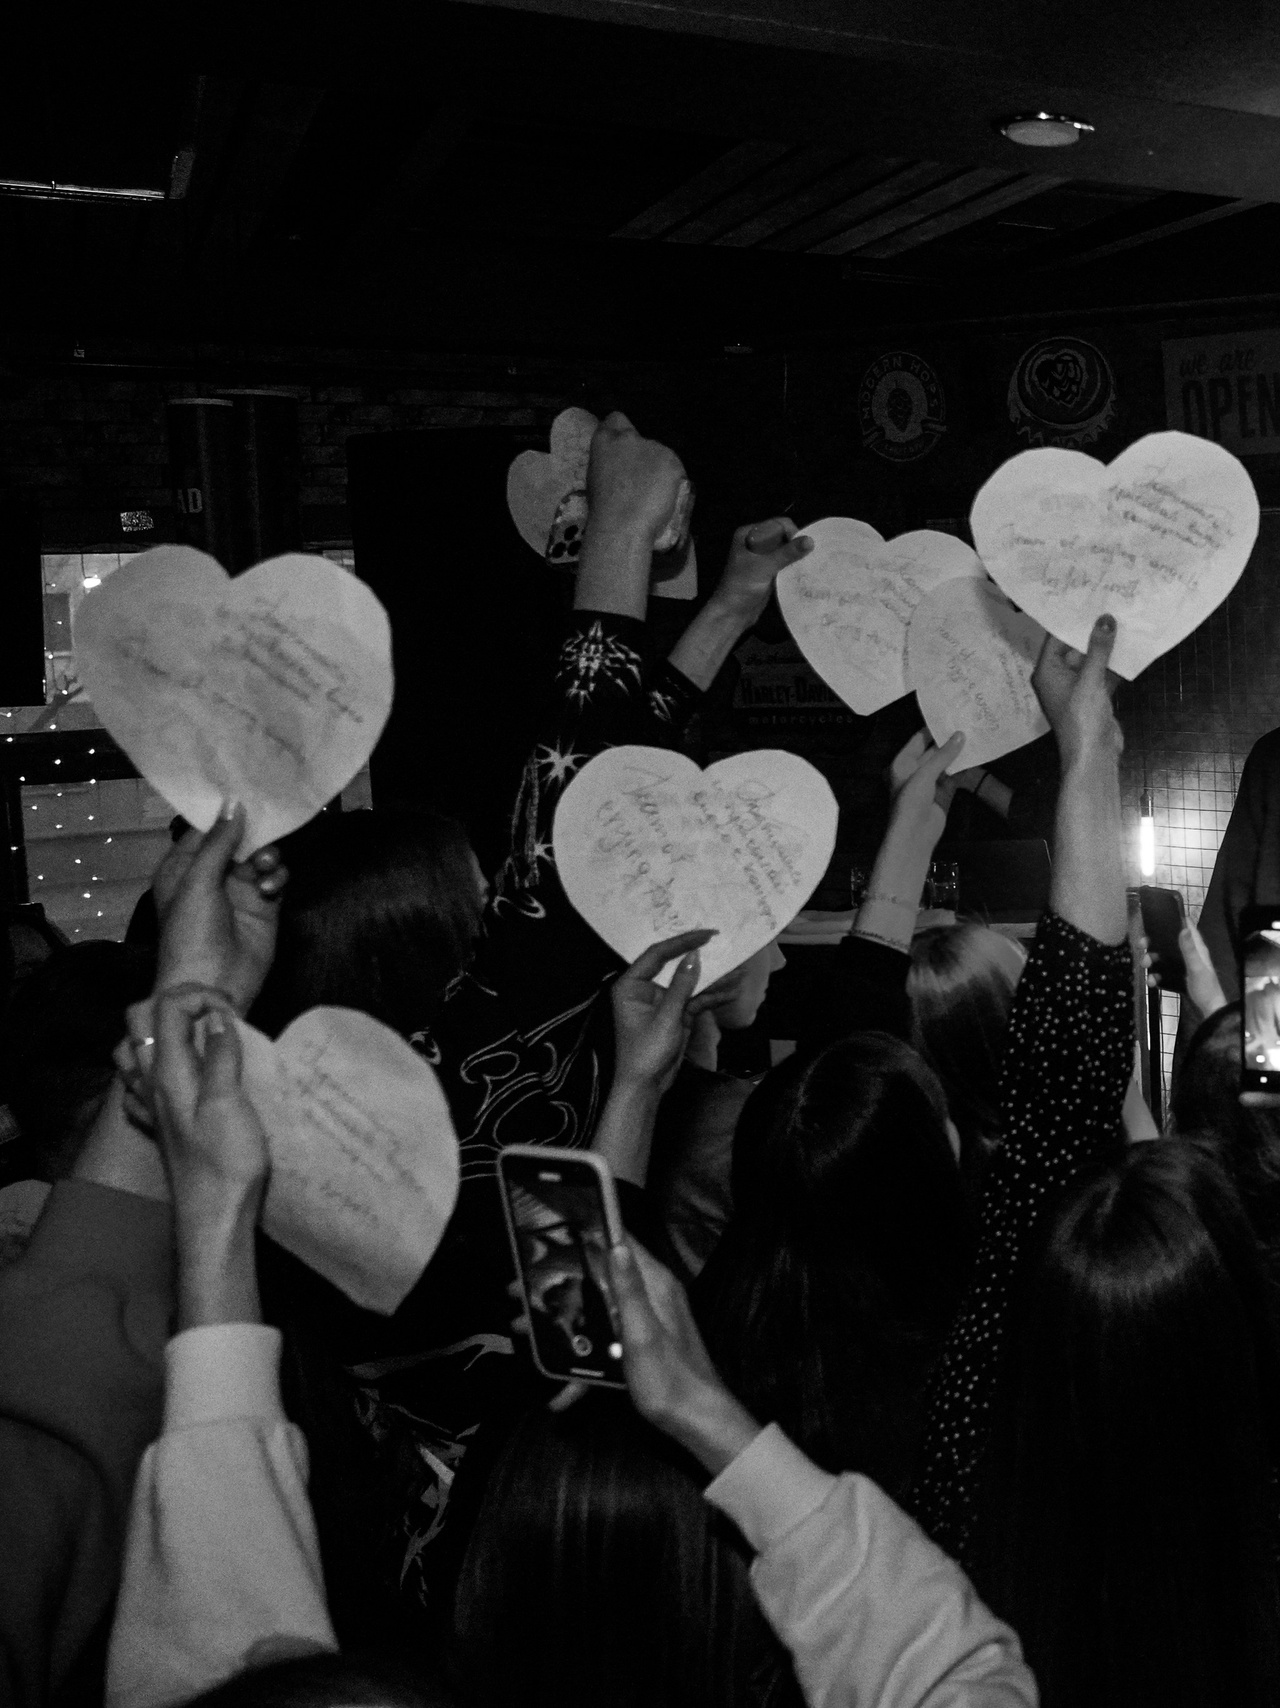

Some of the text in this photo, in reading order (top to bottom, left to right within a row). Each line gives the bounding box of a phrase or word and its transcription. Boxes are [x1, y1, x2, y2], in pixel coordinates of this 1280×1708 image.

[1179, 348, 1255, 377] we are
[861, 355, 939, 420] MODERN HOPS
